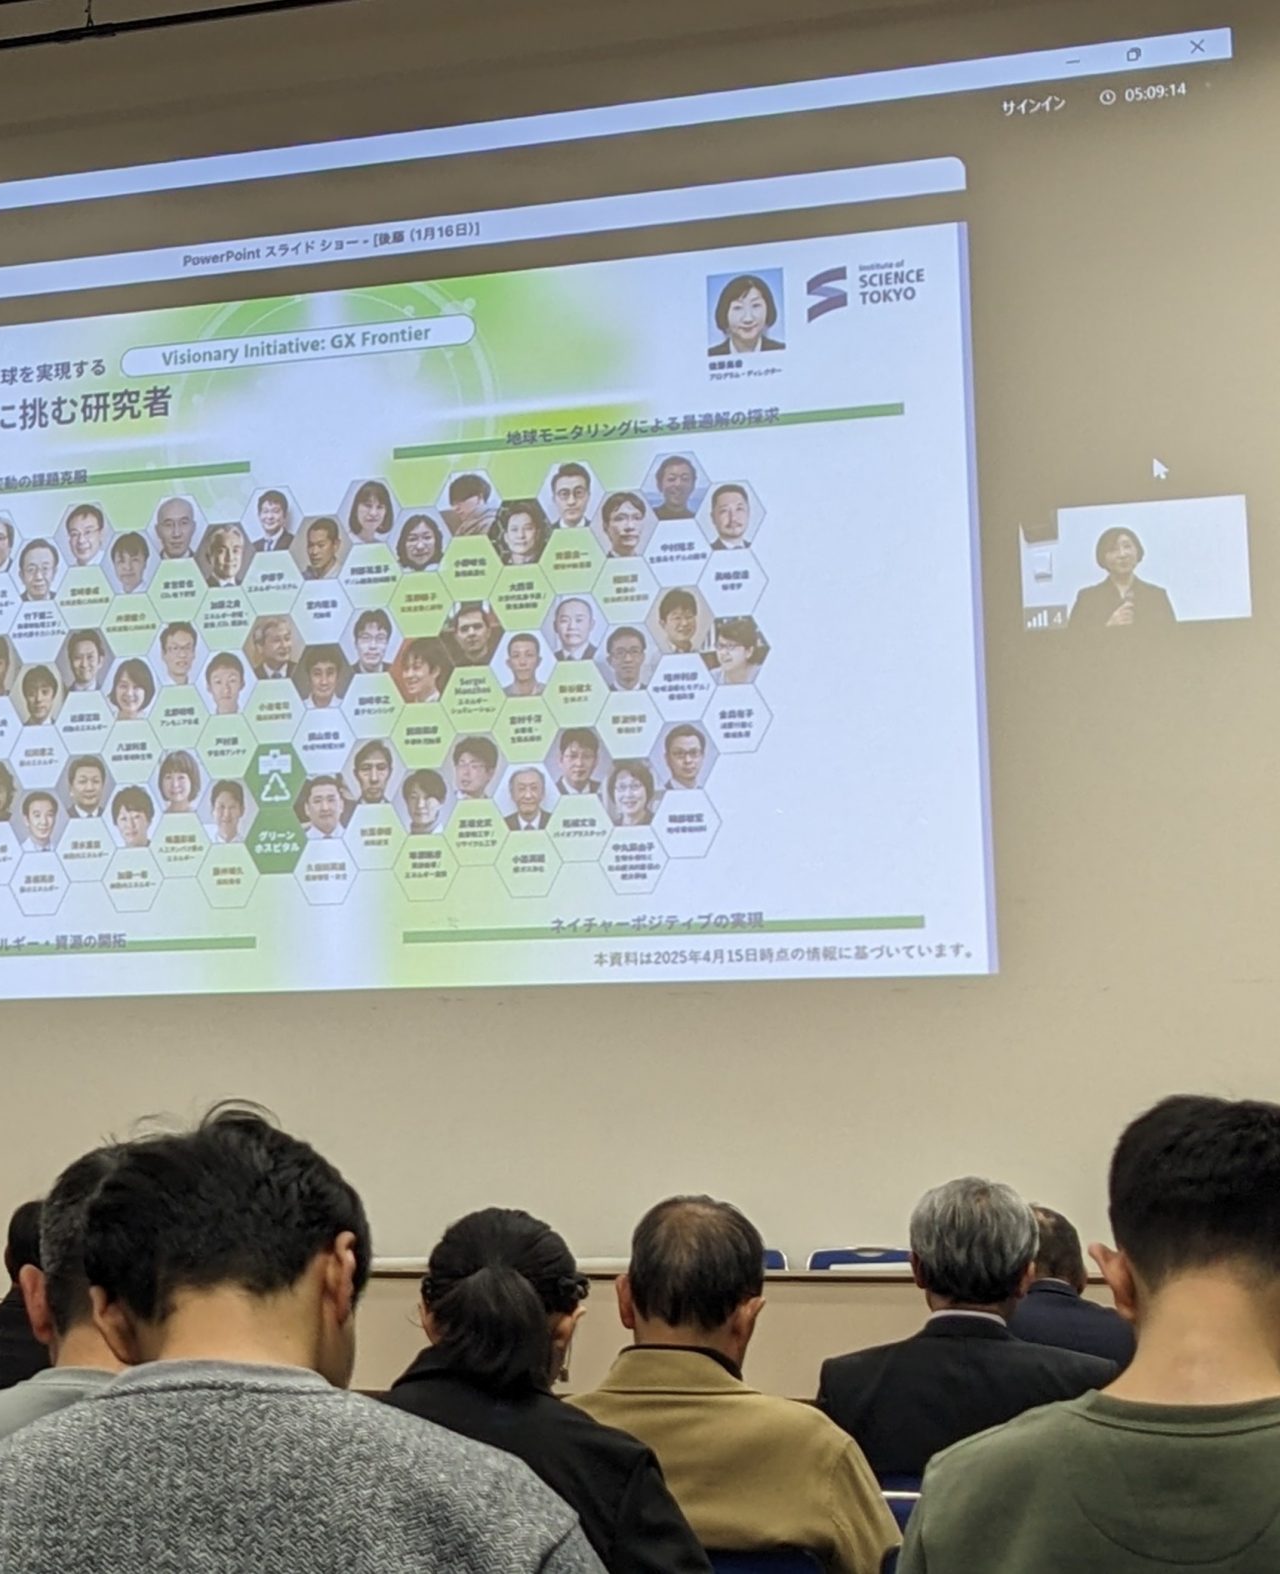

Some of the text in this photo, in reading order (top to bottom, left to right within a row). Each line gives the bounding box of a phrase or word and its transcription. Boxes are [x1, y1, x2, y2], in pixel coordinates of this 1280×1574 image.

[1124, 82, 1187, 101] 05:09:14
[1002, 95, 1066, 116] サインイン
[182, 246, 261, 267] PowerPoint
[265, 240, 315, 258] スライド
[320, 238, 359, 253] ショー
[894, 259, 905, 269] of
[858, 268, 926, 289] SCIENCE
[858, 286, 917, 305] TOKYO
[161, 325, 432, 367] Visionary Initiative: GX Frontier
[258, 830, 296, 842] グリーン
[254, 842, 301, 854] ホスピタル
[550, 911, 765, 935] ネイチャーポジティブの実現
